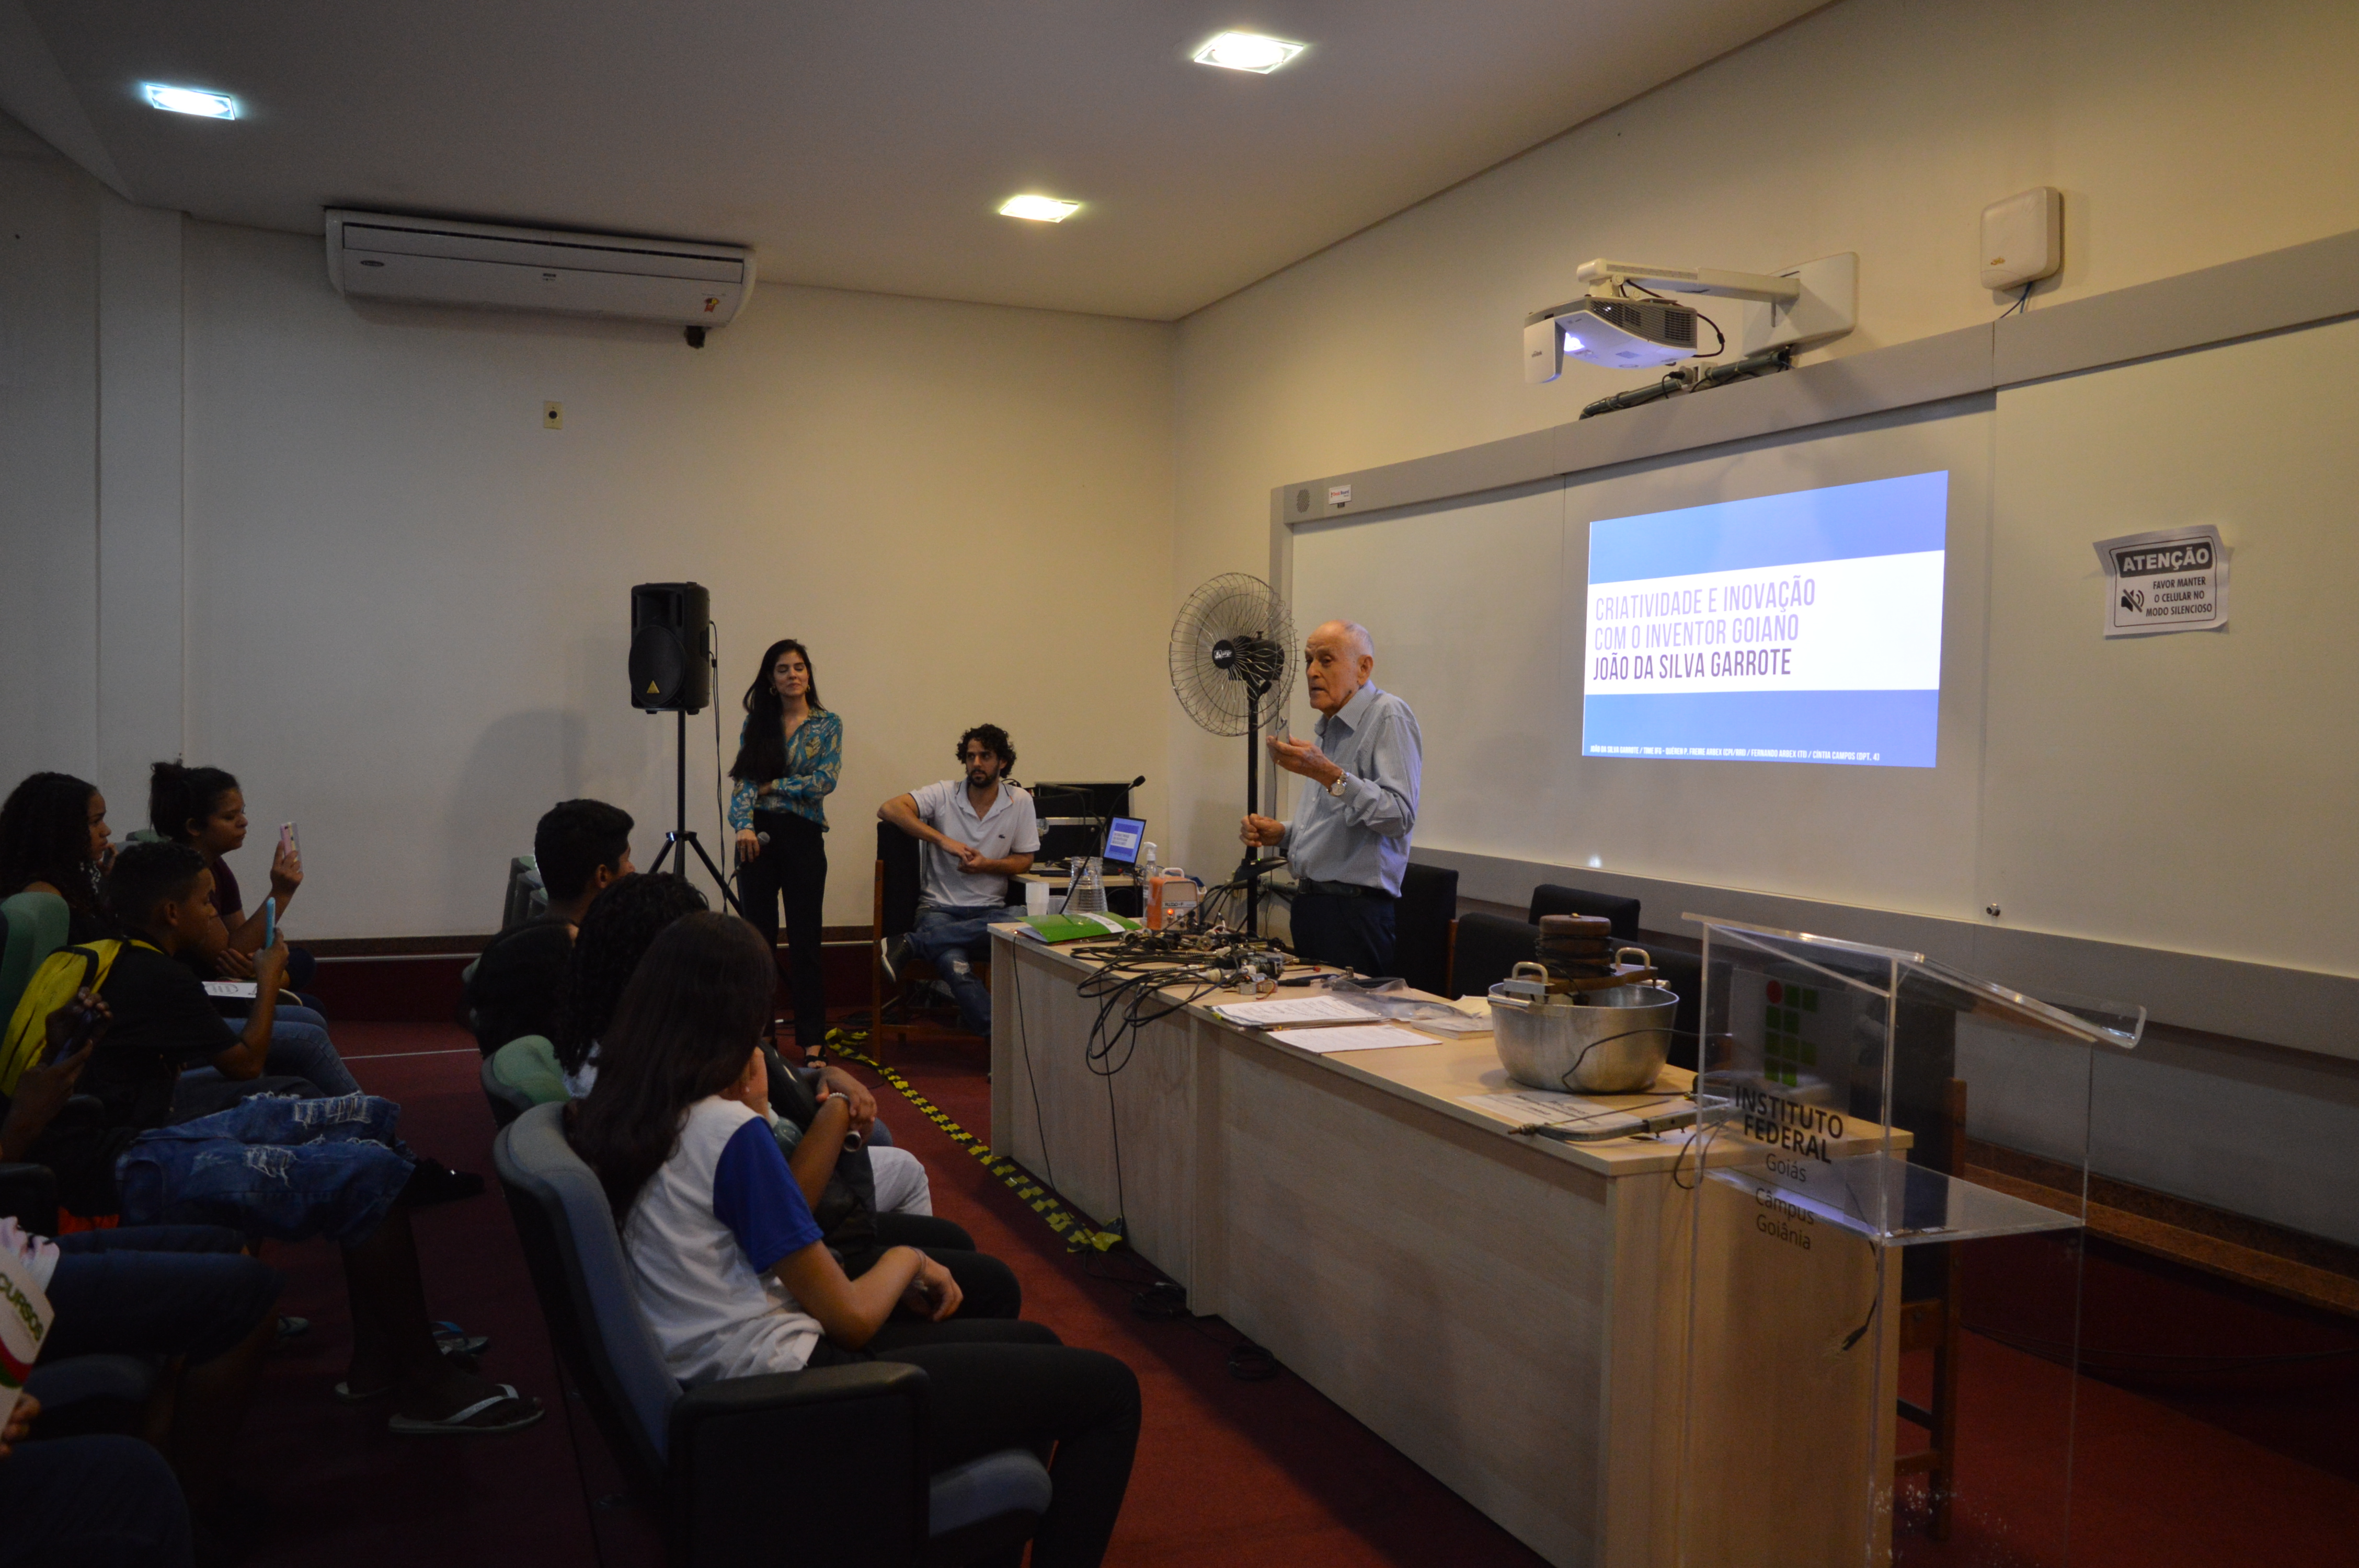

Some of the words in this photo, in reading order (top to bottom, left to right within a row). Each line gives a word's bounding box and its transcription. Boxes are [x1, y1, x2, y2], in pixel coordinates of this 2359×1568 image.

[2123, 547, 2209, 572] ATENÇÃO
[1596, 589, 1703, 621] CRIATIVIDADE
[1709, 587, 1717, 612] E
[1724, 575, 1816, 613] INOVAÇÃO
[2153, 580, 2175, 590] FAVOR
[2177, 577, 2206, 586] MANTER
[2154, 594, 2159, 603] O
[2162, 592, 2191, 603] CELULAR
[2194, 590, 2205, 599] NO
[2146, 606, 2169, 617] MODO
[2171, 603, 2212, 615] SILENCIOSO
[1595, 626, 1627, 651] COM
[1631, 625, 1641, 649] O
[1646, 619, 1726, 648] INVENTOR
[1732, 614, 1800, 643] GOIANO
[1593, 652, 1629, 681] JOÃO
[1634, 655, 1654, 679] DA
[1659, 652, 1705, 678] SILVA
[1711, 648, 1792, 677] GARROTE
[1590, 744, 1600, 753] JOÃO
[1751, 749, 1778, 757] FERNANDO
[1779, 750, 1796, 758] ARBEX
[1813, 750, 1831, 759] CÍNTIA
[1832, 752, 1856, 760] CAMPOS
[1735, 1086, 1843, 1139] INSTITUTO
[1744, 1114, 1831, 1165] FEDERAL
[1766, 1153, 1806, 1182] Goiás
[1756, 1187, 1815, 1225] Câmpus
[1756, 1215, 1811, 1250] Goiânia
